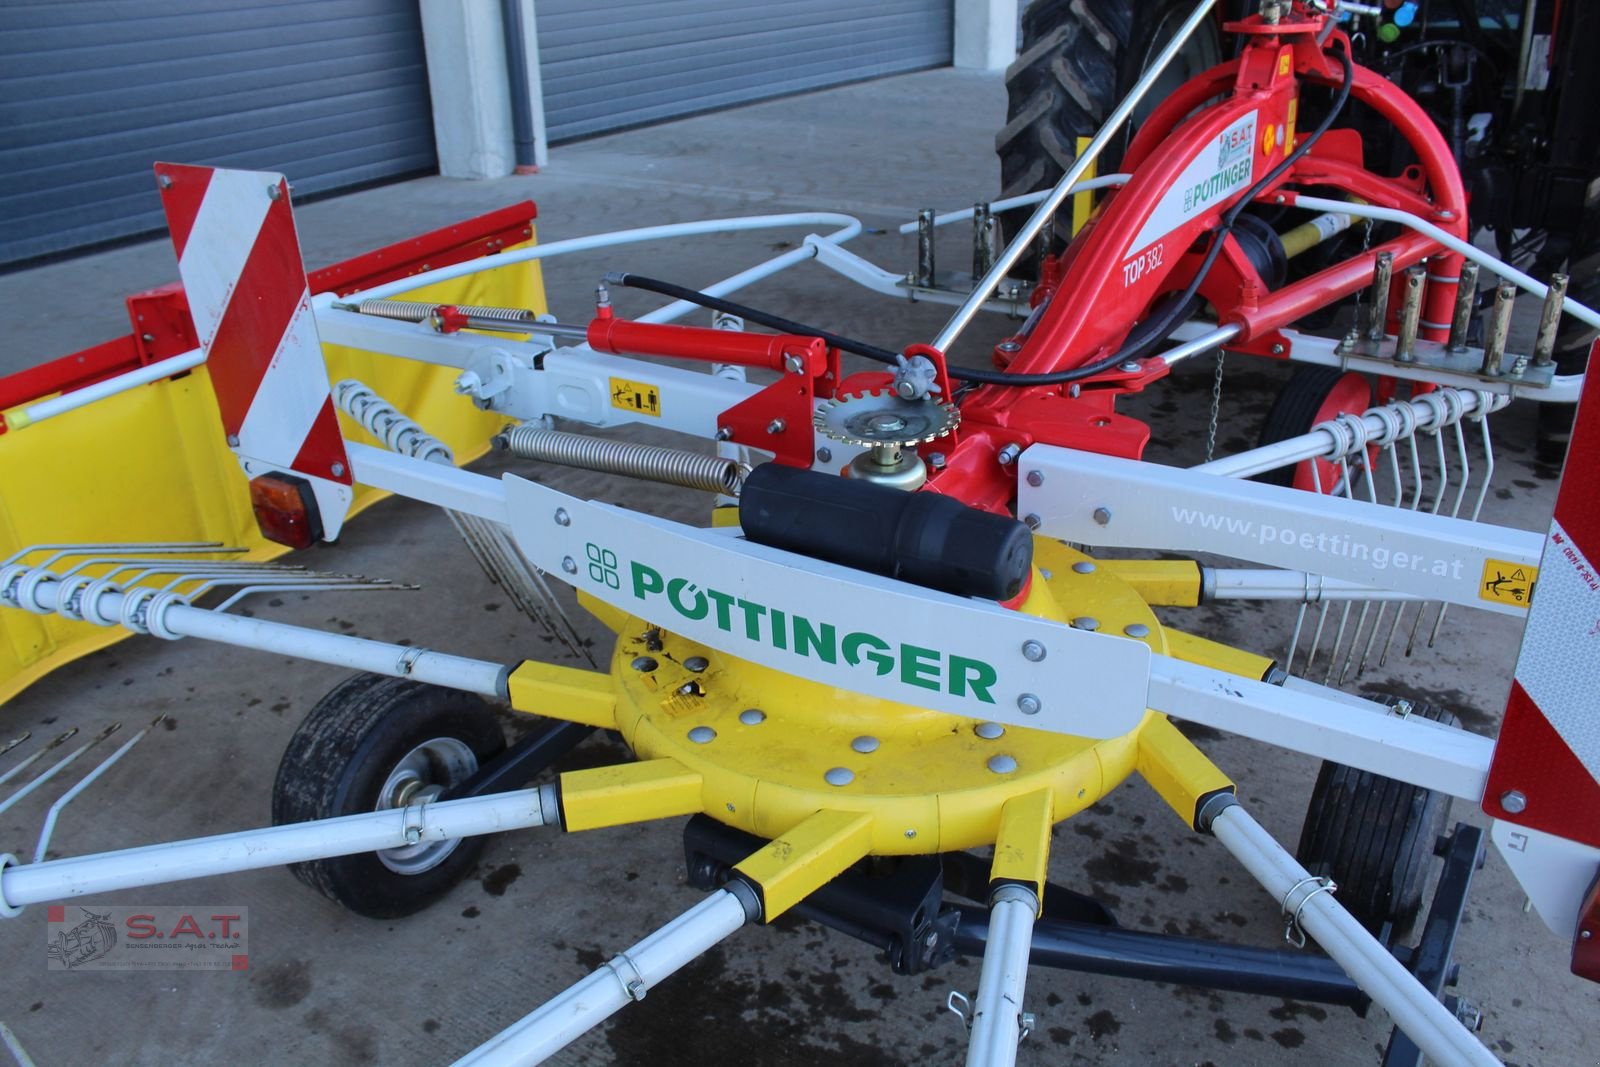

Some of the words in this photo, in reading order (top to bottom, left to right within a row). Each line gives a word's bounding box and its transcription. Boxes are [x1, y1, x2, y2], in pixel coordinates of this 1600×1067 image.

[1123, 257, 1145, 288] TOP
[1145, 243, 1164, 274] 382
[1171, 505, 1465, 581] www.poettinger.at
